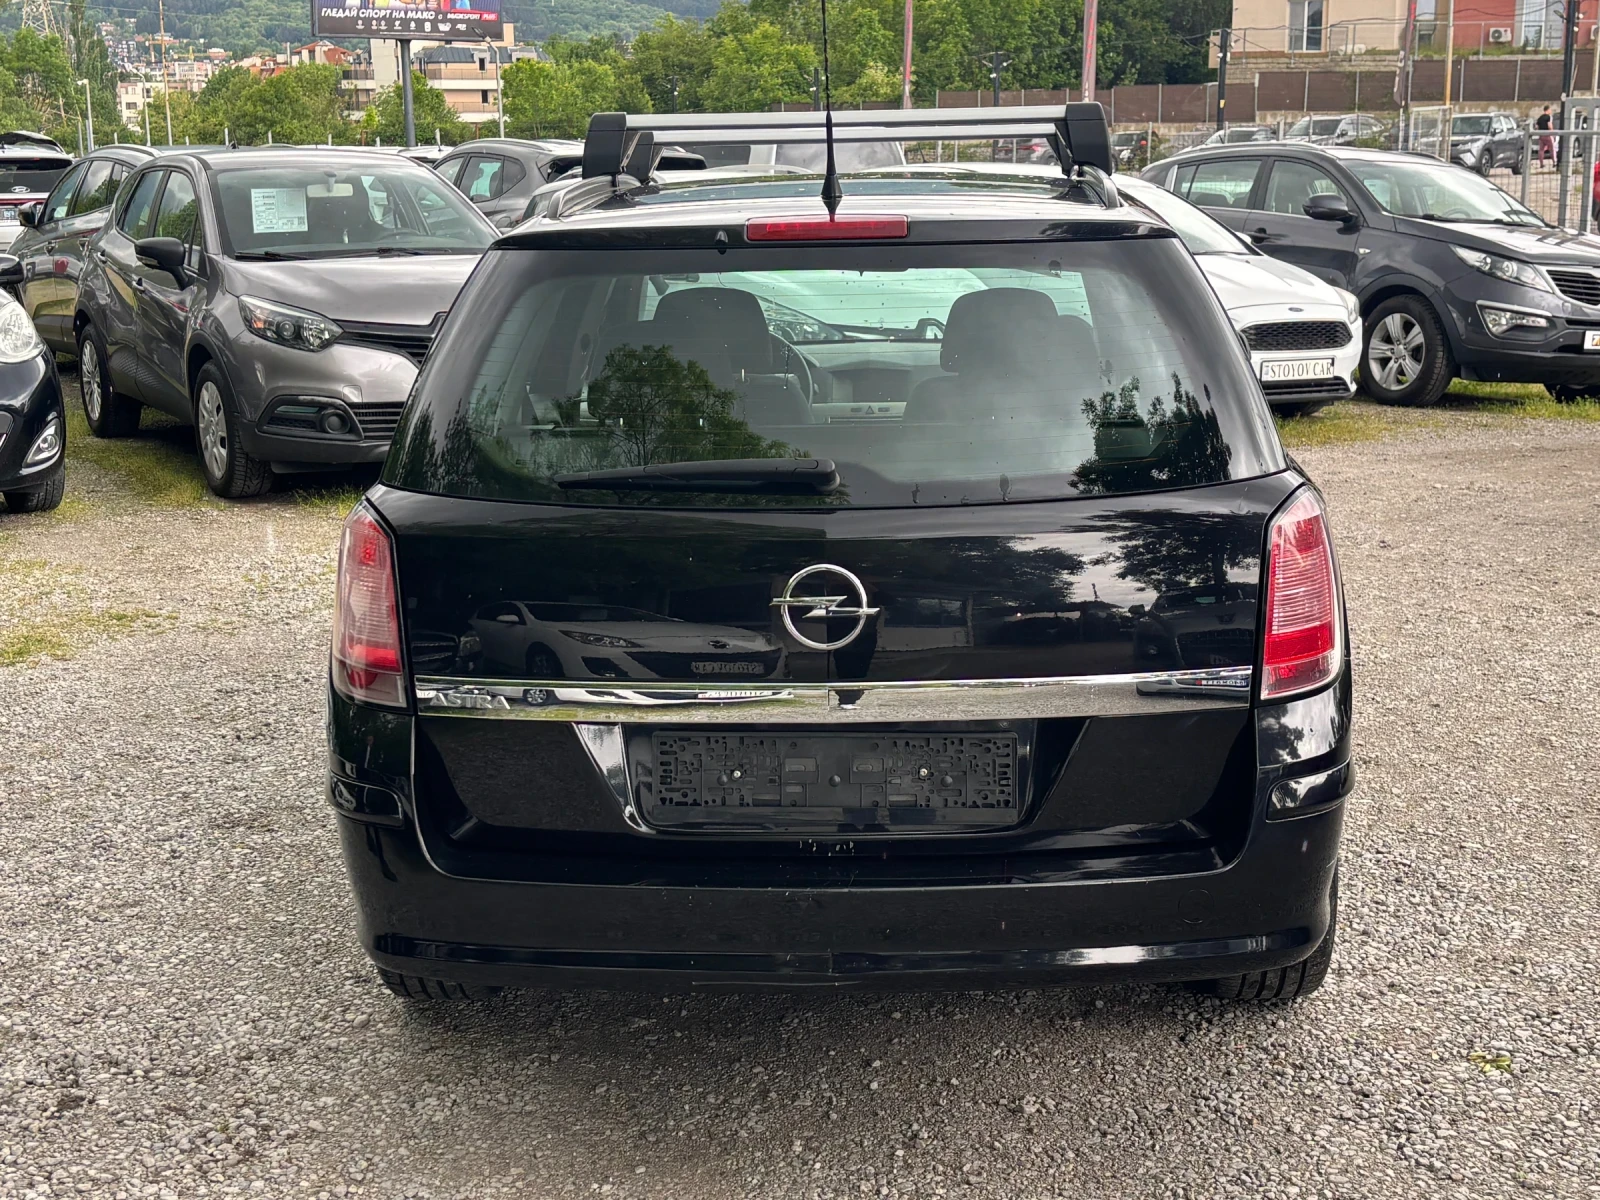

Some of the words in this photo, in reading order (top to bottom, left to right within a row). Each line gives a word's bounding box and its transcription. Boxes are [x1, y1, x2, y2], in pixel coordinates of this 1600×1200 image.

[321, 7, 358, 18] ГЛЕДАЙ
[359, 9, 391, 18] СПОРТ
[392, 10, 406, 18] НА
[406, 10, 436, 19] МАКС
[1270, 362, 1311, 379] STOYOV
[1313, 362, 1332, 376] CAR
[430, 692, 511, 709] ASTRA
